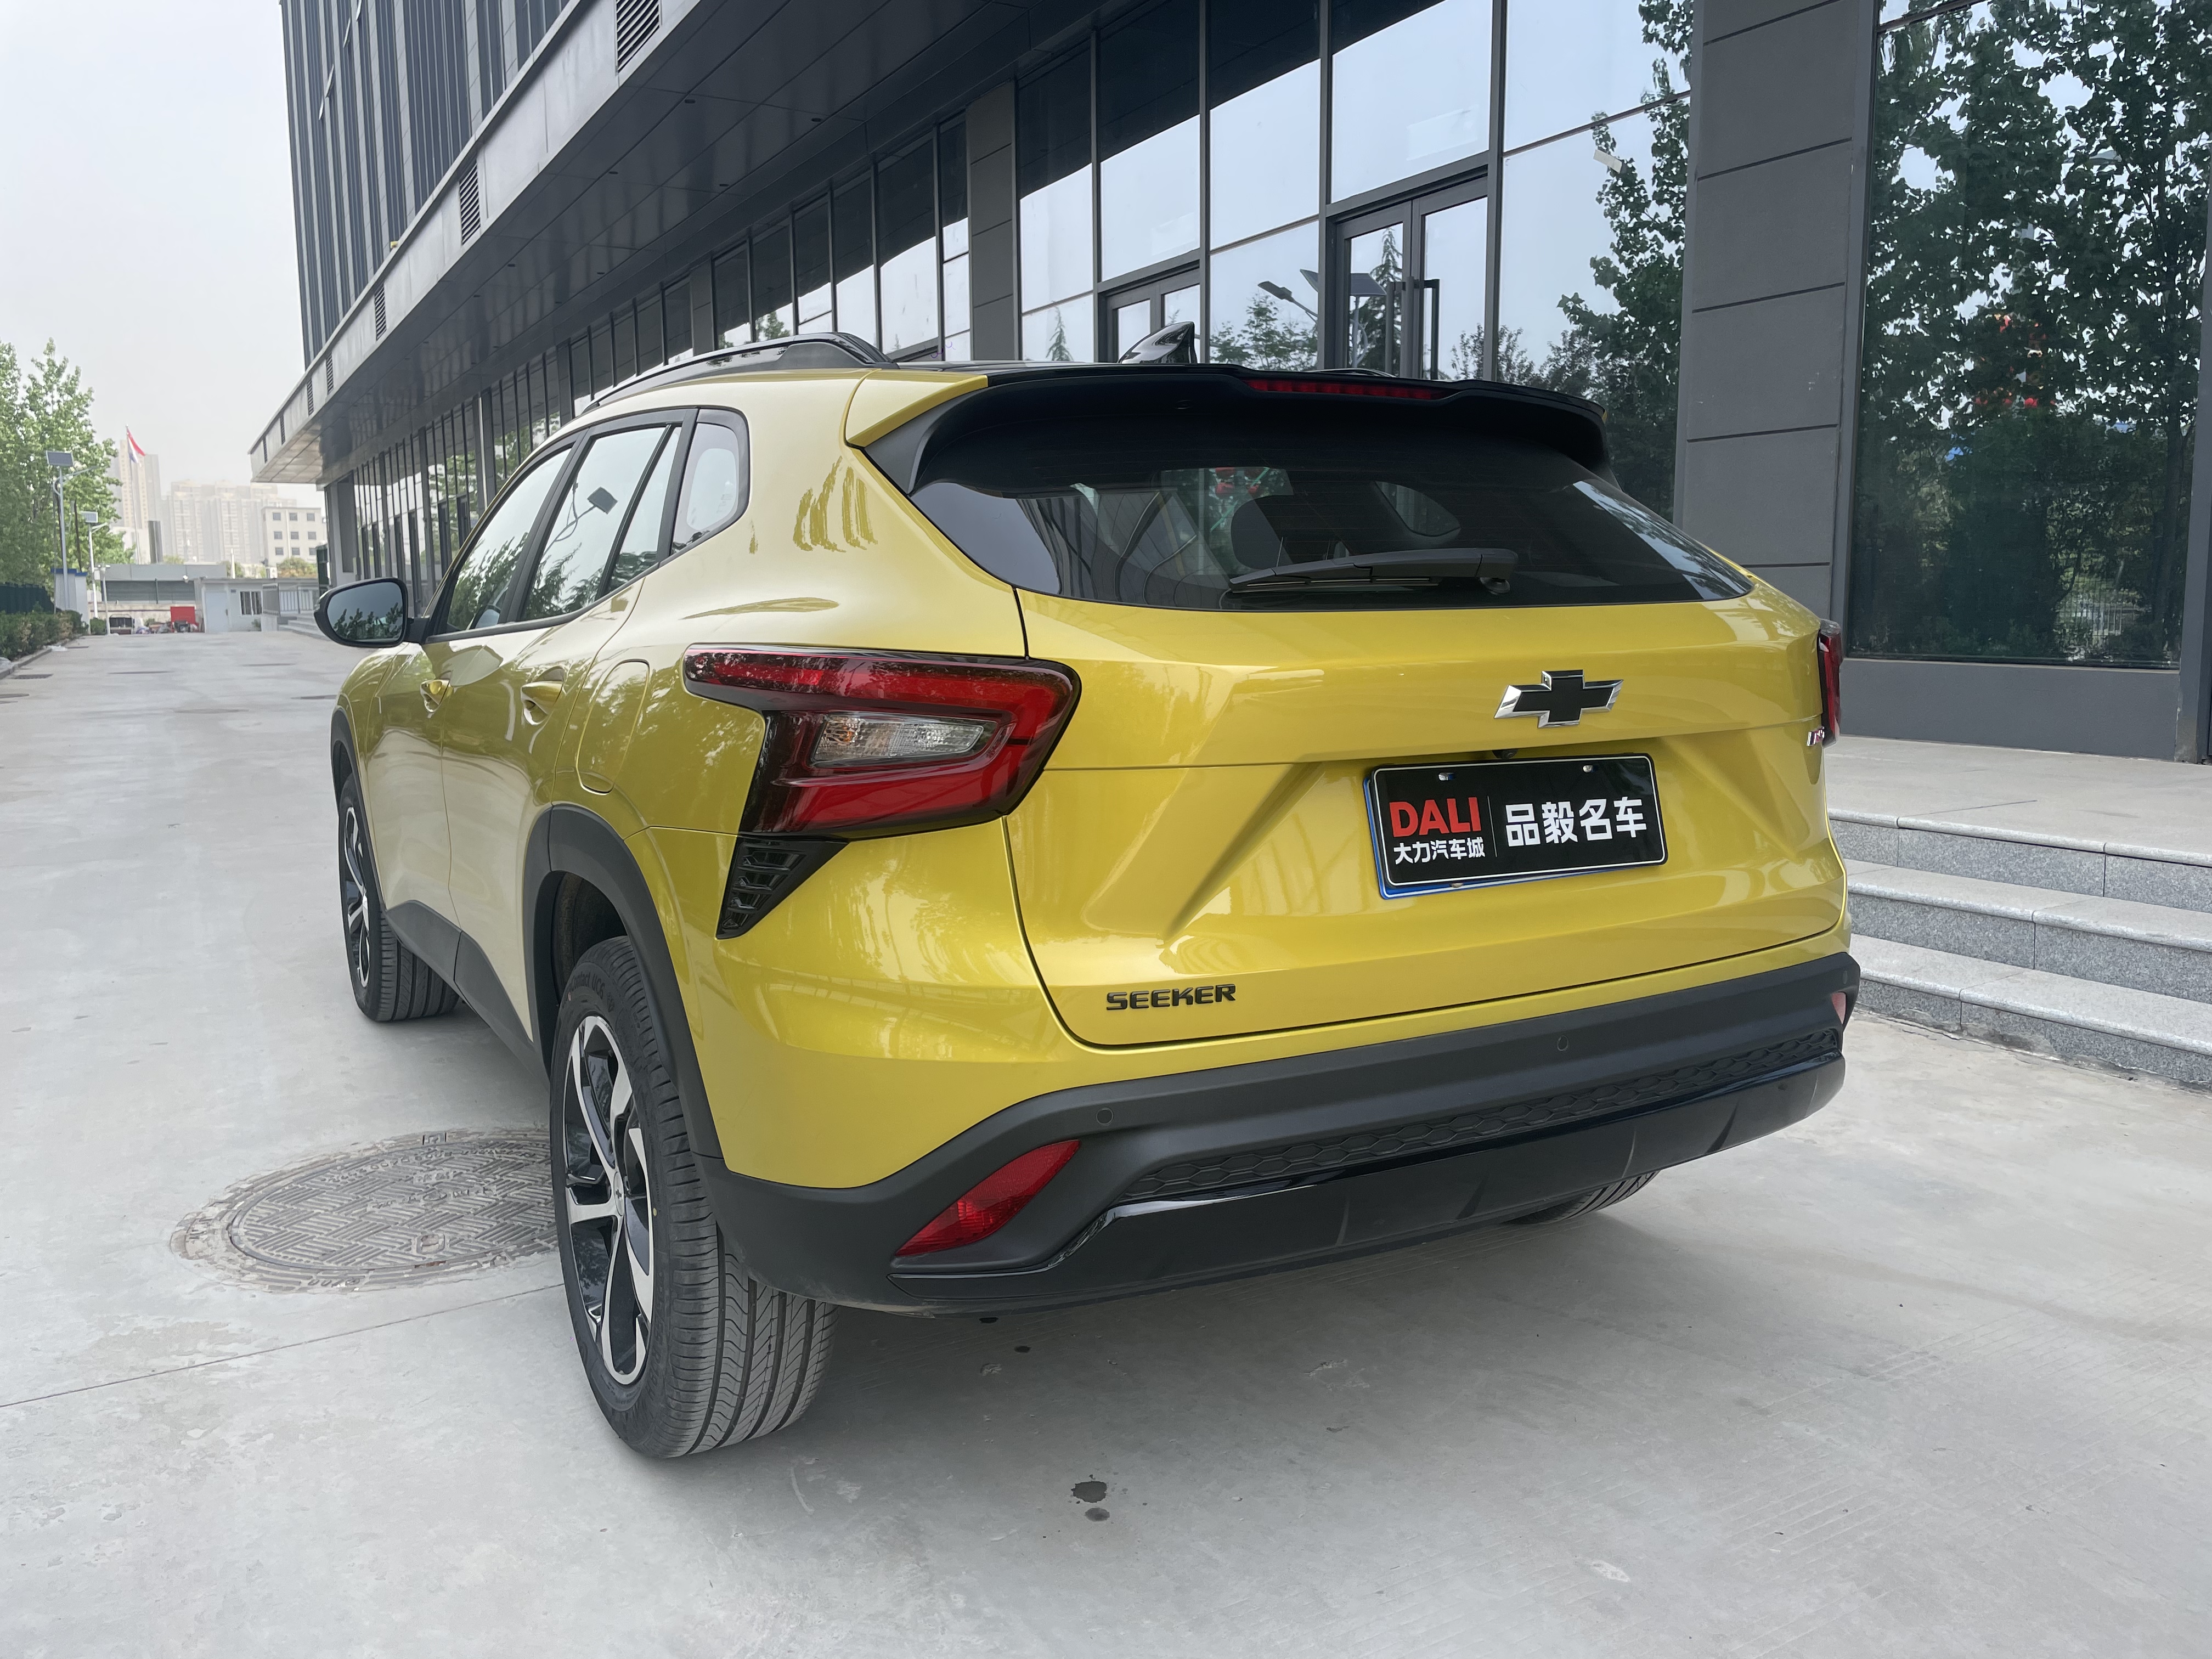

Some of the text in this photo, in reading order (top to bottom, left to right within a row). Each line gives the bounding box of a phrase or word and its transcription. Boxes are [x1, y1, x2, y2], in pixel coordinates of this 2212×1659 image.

[1389, 797, 1481, 837] DALI
[1505, 797, 1647, 847] 品毅名车
[1393, 837, 1486, 865] 大力汽车城
[1106, 984, 1236, 1011] SEEKER
